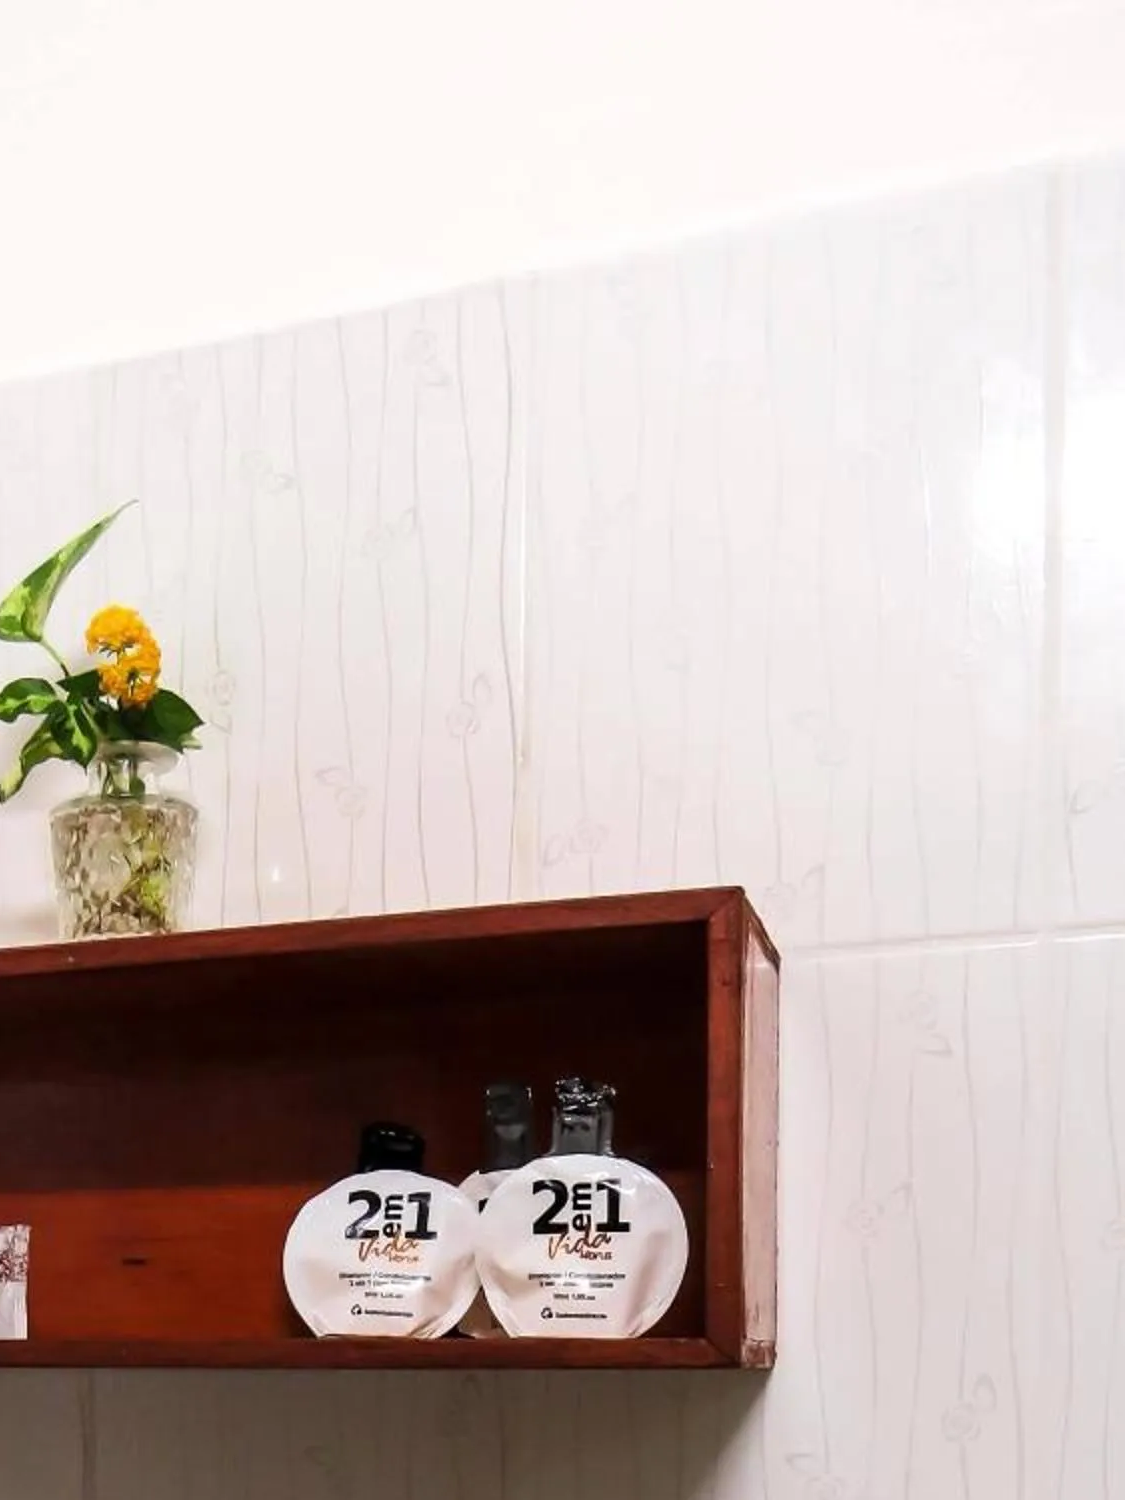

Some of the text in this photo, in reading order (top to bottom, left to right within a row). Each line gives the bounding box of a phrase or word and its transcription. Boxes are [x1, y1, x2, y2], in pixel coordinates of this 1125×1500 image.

[345, 1190, 438, 1240] 2 em 1
[533, 1178, 630, 1234] 2 em 1
[358, 1229, 419, 1262] Vida
[548, 1226, 612, 1260] Vida
